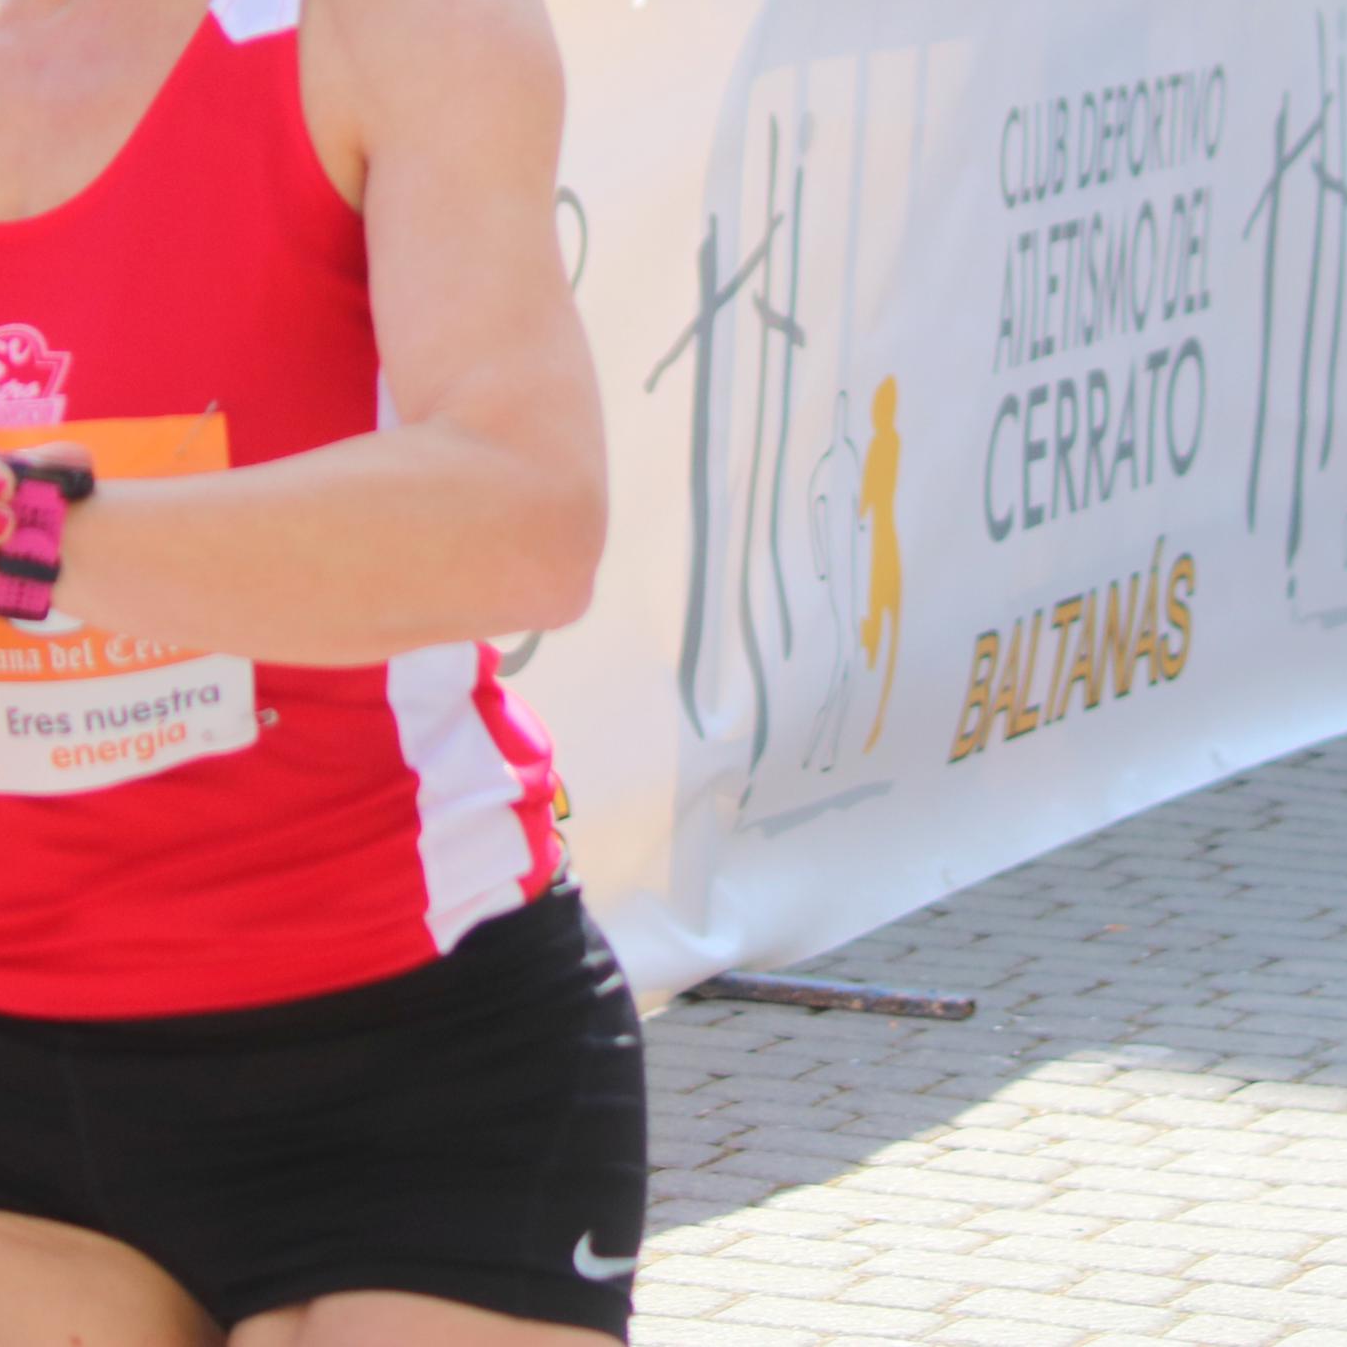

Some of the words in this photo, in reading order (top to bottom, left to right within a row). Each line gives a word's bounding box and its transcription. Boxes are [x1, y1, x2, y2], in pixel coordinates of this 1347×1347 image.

[1001, 97, 1069, 209] CLUB
[1077, 62, 1226, 190] DEPORTIVO
[993, 198, 1158, 376] ATLETISMO
[1162, 185, 1212, 322] DEL
[984, 337, 1207, 542] CERRATO
[6, 706, 72, 737] Eres
[85, 681, 221, 732] nuestra
[49, 637, 97, 673] del
[947, 535, 1197, 765] BALTANÁS
